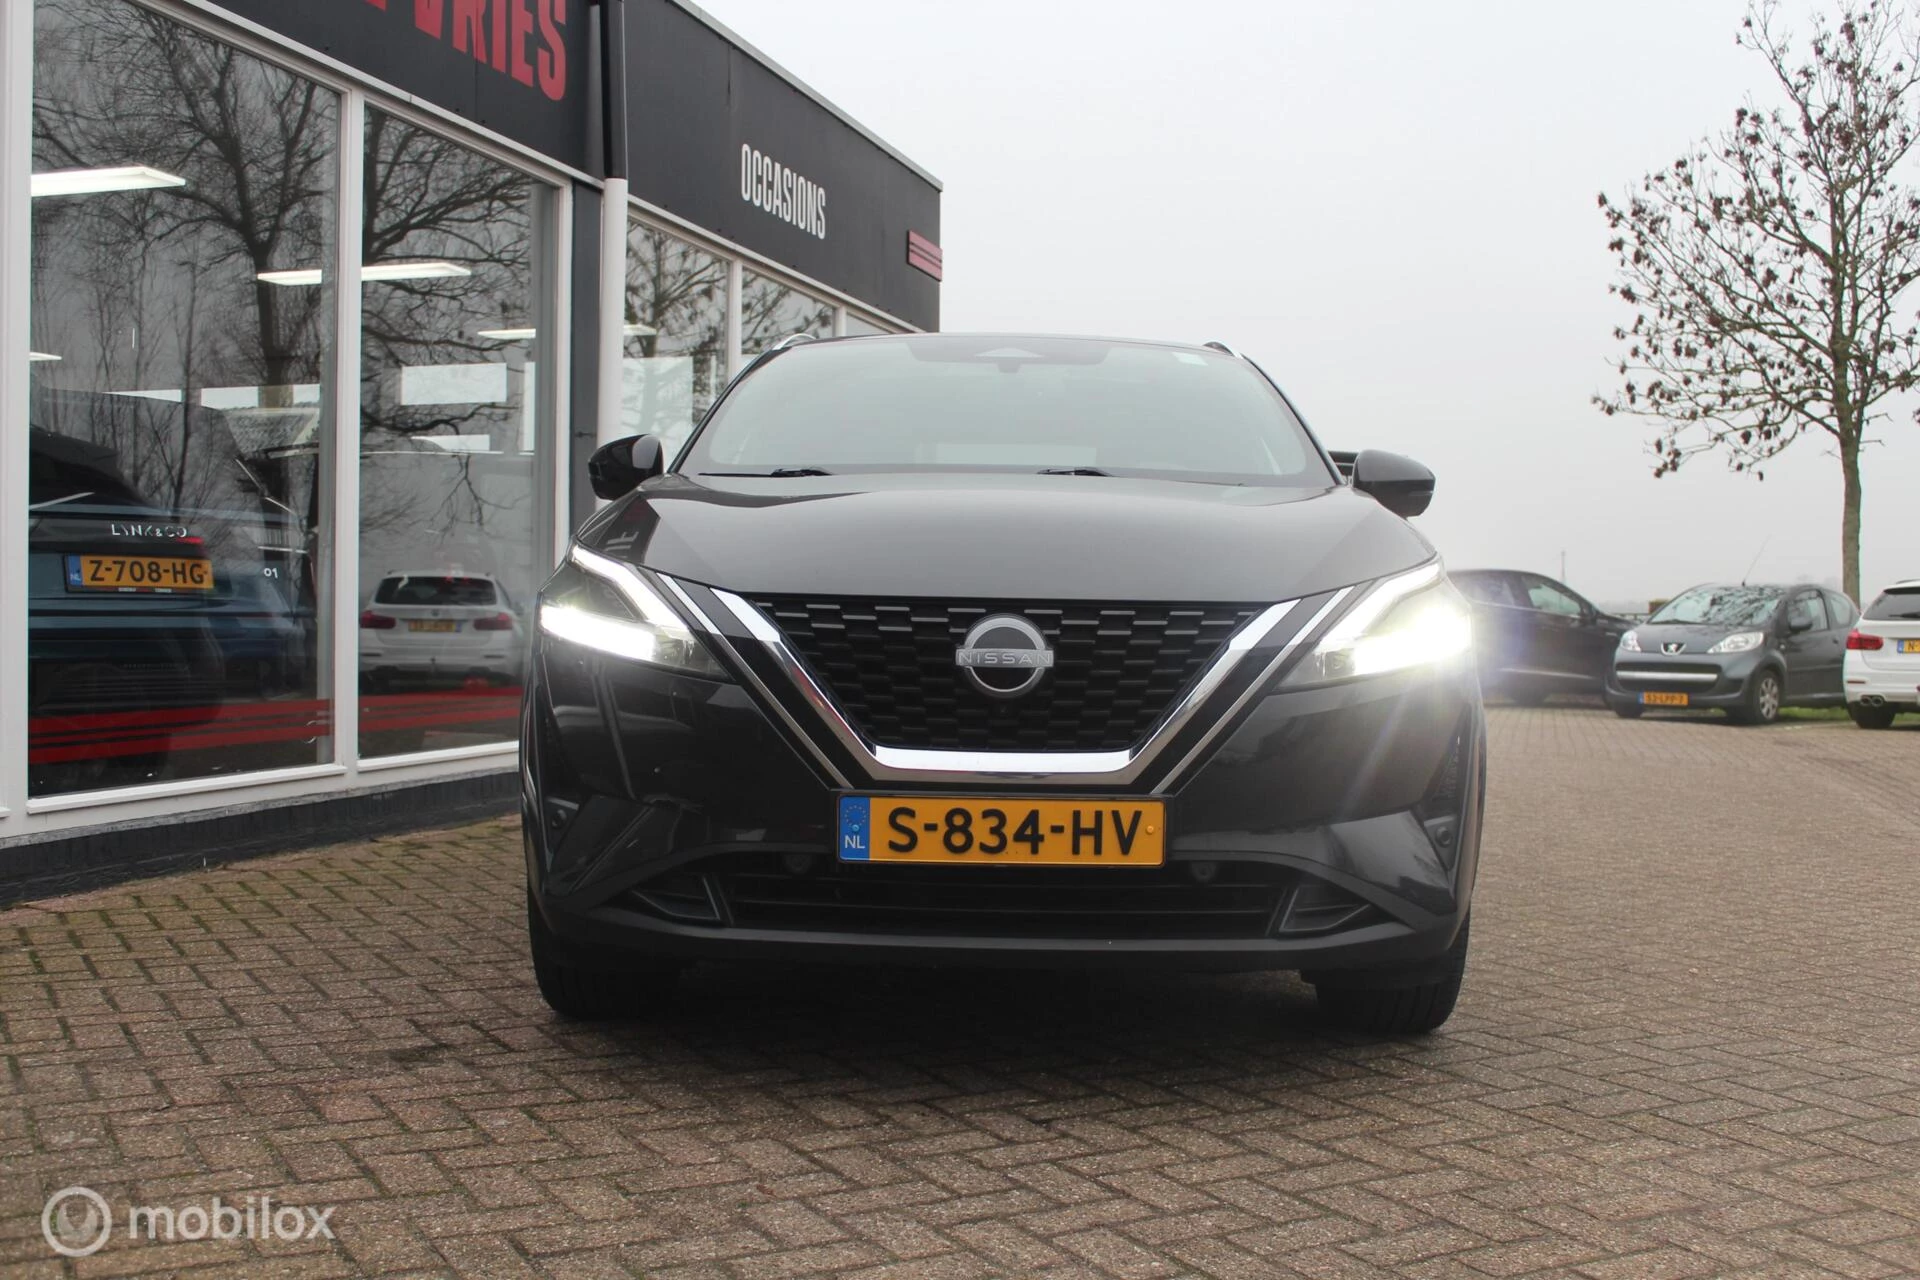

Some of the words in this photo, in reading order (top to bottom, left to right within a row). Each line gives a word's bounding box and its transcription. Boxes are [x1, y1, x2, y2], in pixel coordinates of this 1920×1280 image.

[414, 0, 567, 101] RIES
[741, 143, 826, 240] OCCASIONS
[89, 559, 205, 584] Z-708-HG
[958, 652, 1051, 665] NISSAN
[844, 835, 866, 849] NL
[887, 806, 1142, 856] S-834-HV
